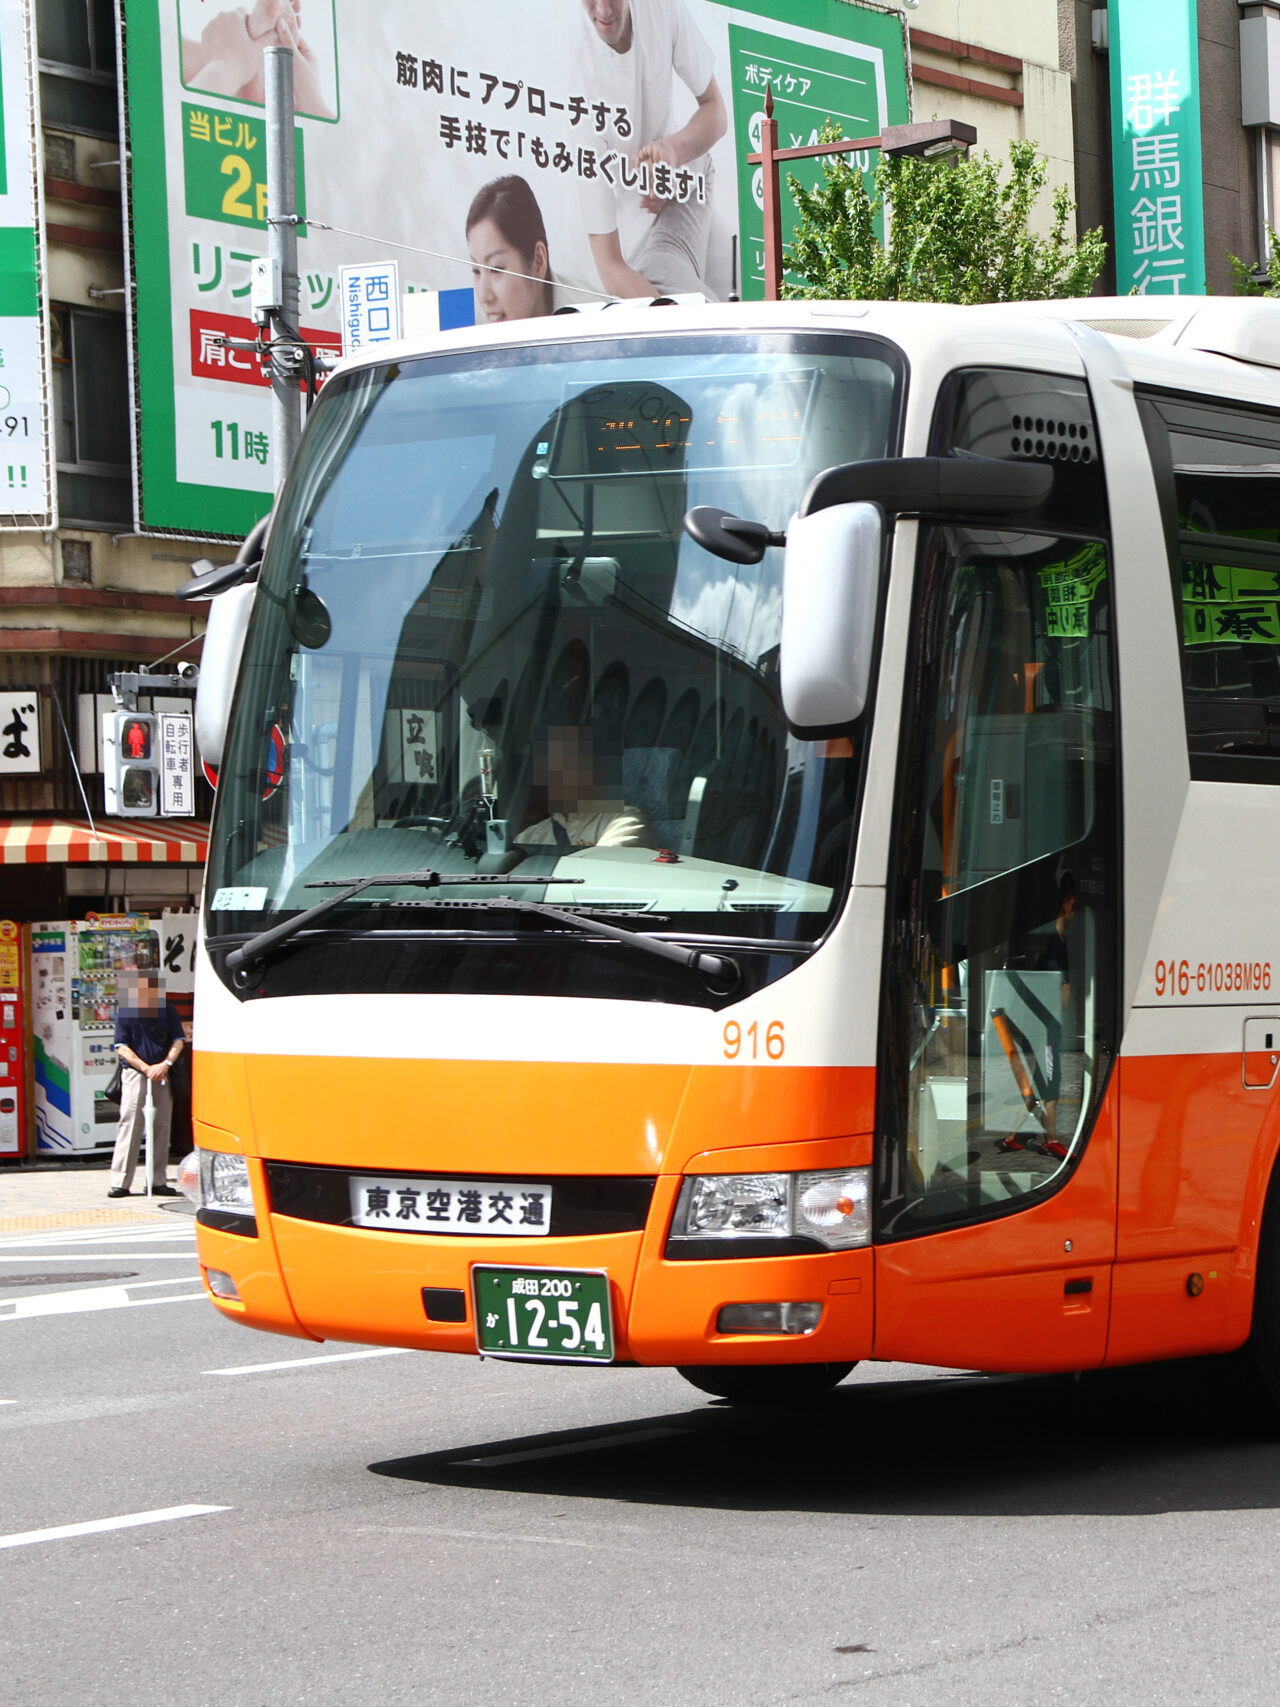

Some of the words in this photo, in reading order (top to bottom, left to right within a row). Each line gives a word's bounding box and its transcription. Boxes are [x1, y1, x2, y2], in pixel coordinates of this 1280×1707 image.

[745, 63, 812, 97] ボディケア
[189, 110, 258, 151] 当ビル
[1126, 68, 1187, 296] 群馬銀行
[365, 275, 391, 342] 西口
[211, 419, 269, 465] 11時
[166, 723, 177, 772] 自転車
[178, 723, 190, 772] 歩行者
[172, 775, 184, 807] 専用
[164, 933, 197, 973] そ
[1155, 959, 1271, 996] 916-61038M96
[723, 1019, 785, 1060] 916
[364, 1186, 545, 1226] 東京空港交通
[485, 1312, 500, 1329] か
[506, 1297, 606, 1351] 12-54
